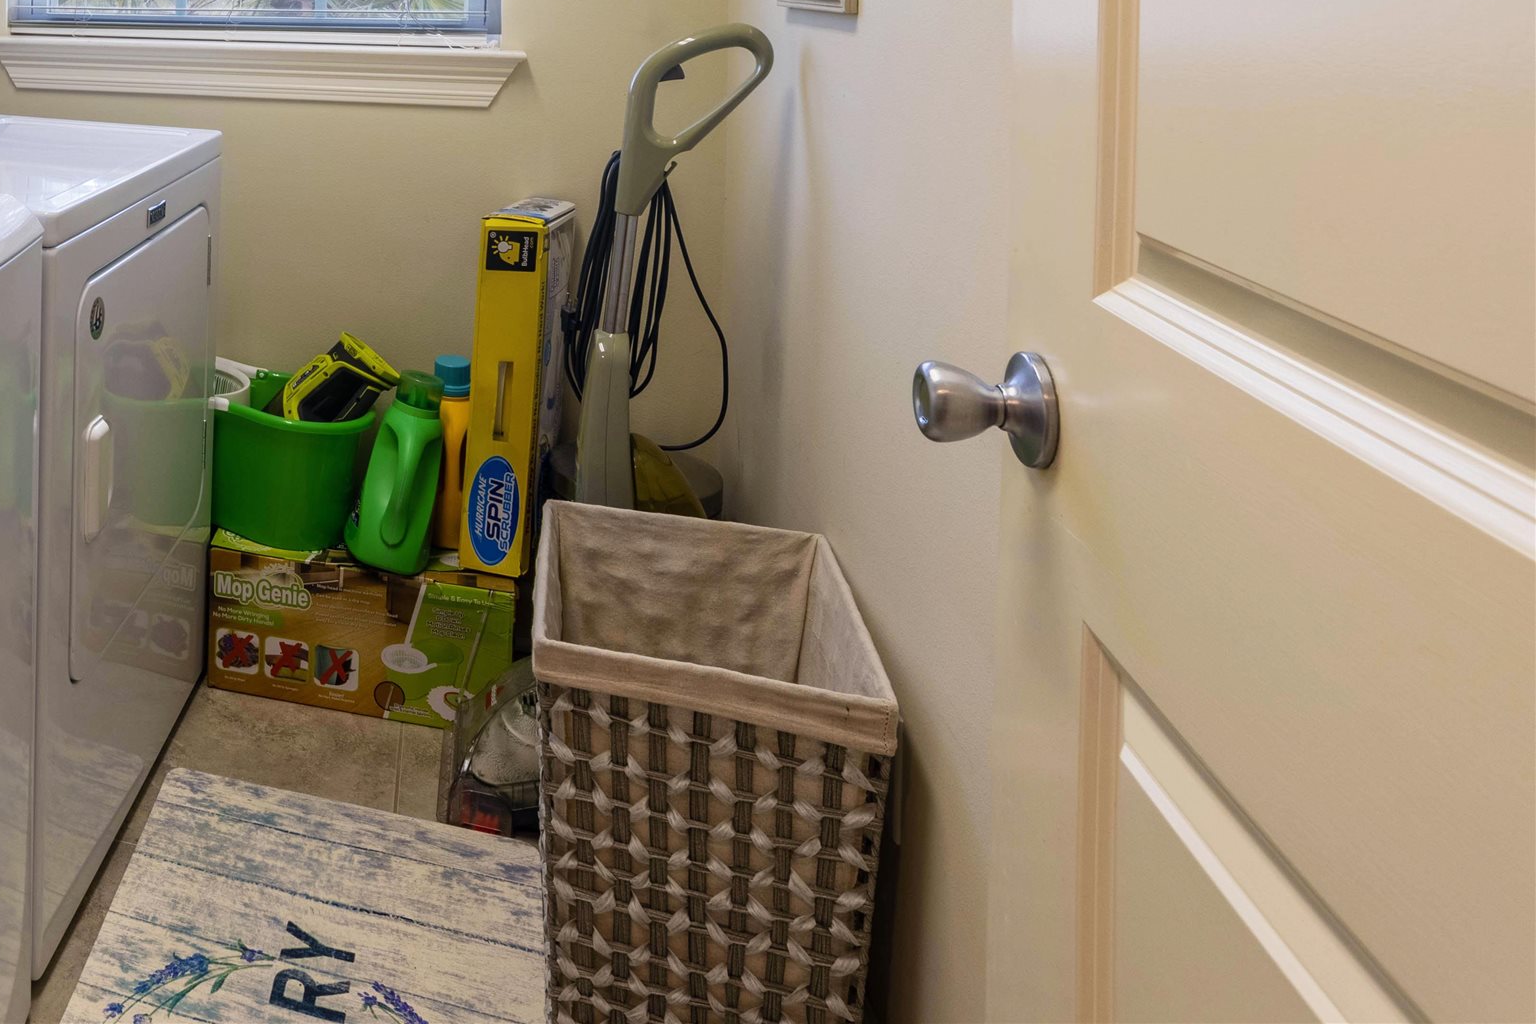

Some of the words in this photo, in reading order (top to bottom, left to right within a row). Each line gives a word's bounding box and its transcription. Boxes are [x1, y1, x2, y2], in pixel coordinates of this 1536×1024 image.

[521, 236, 530, 267] BulbHead
[474, 473, 487, 537] HURRICANE
[484, 477, 505, 541] SPIN
[498, 472, 515, 553] SCRUBBER
[216, 573, 253, 603] Mop
[257, 579, 310, 608] Genie
[221, 613, 238, 621] More
[238, 615, 253, 625] Dirty
[227, 607, 242, 615] More
